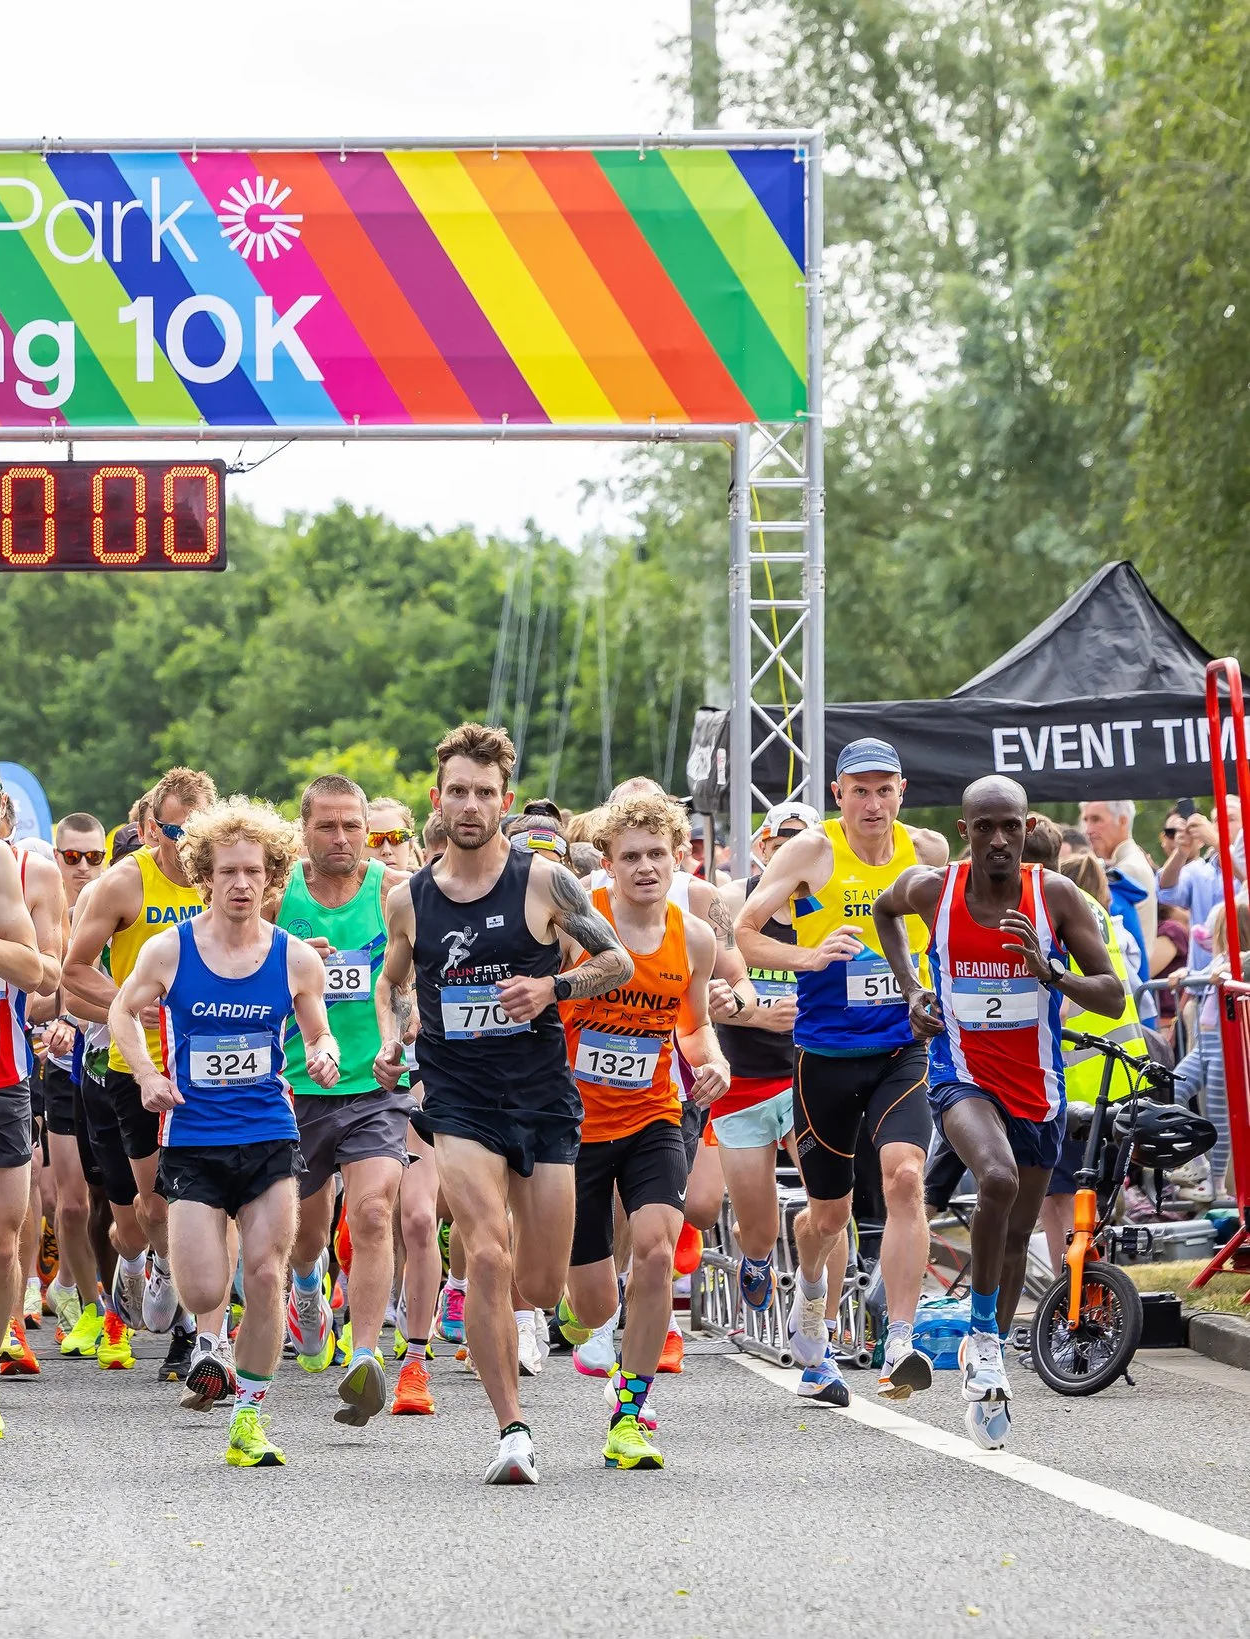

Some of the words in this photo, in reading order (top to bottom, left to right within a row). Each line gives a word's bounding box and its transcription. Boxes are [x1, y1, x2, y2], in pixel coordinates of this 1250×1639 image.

[117, 293, 326, 384] 10K
[92, 466, 218, 564] 00
[992, 720, 1143, 773] EVENT
[1152, 715, 1250, 765] TIM
[844, 890, 858, 902] ST
[446, 963, 510, 978] RUNFAST
[447, 971, 512, 985] COACHING
[955, 961, 1010, 978] READING
[191, 1001, 272, 1020] CARDIFF
[574, 1003, 676, 1025] FITNESS
[985, 997, 1002, 1019] 2
[988, 1021, 1020, 1029] RUNNING
[206, 1052, 258, 1077] 324
[588, 1051, 647, 1078] 1321
[227, 1077, 257, 1086] RUNNING
[593, 1075, 602, 1083] UP
[608, 1078, 639, 1088] RUNNING
